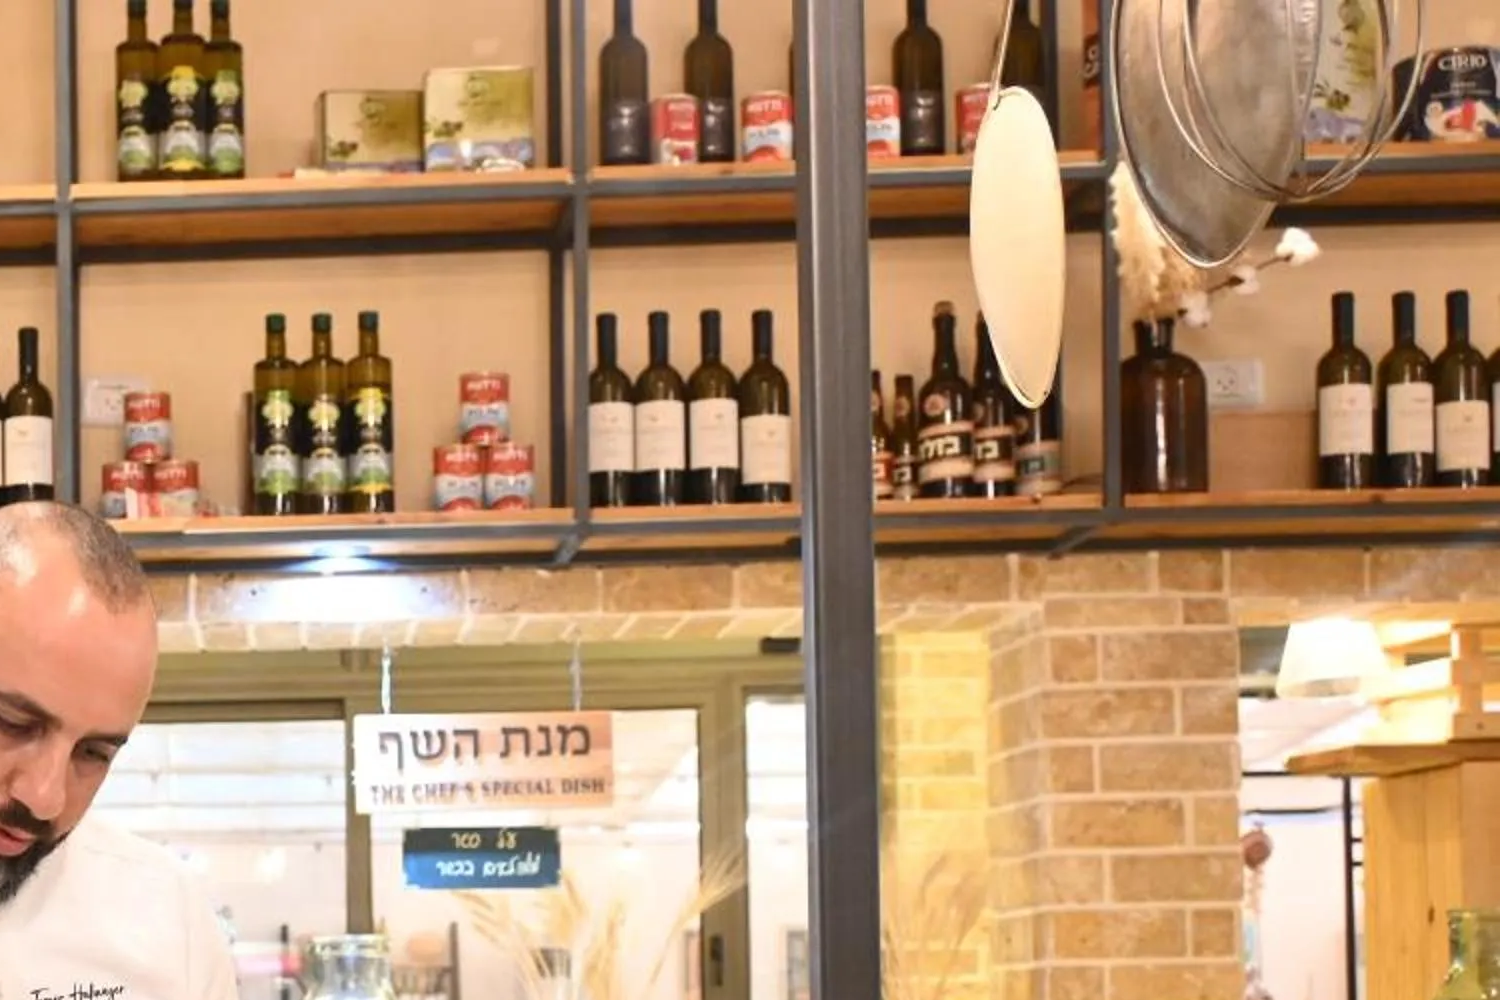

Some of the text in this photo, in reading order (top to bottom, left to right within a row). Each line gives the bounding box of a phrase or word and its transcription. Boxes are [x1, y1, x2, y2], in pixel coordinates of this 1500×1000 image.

[1437, 53, 1488, 71] CIRIO
[378, 722, 591, 775] מנת השף
[370, 777, 606, 805] THE CHEF'S SPECIAL DISH
